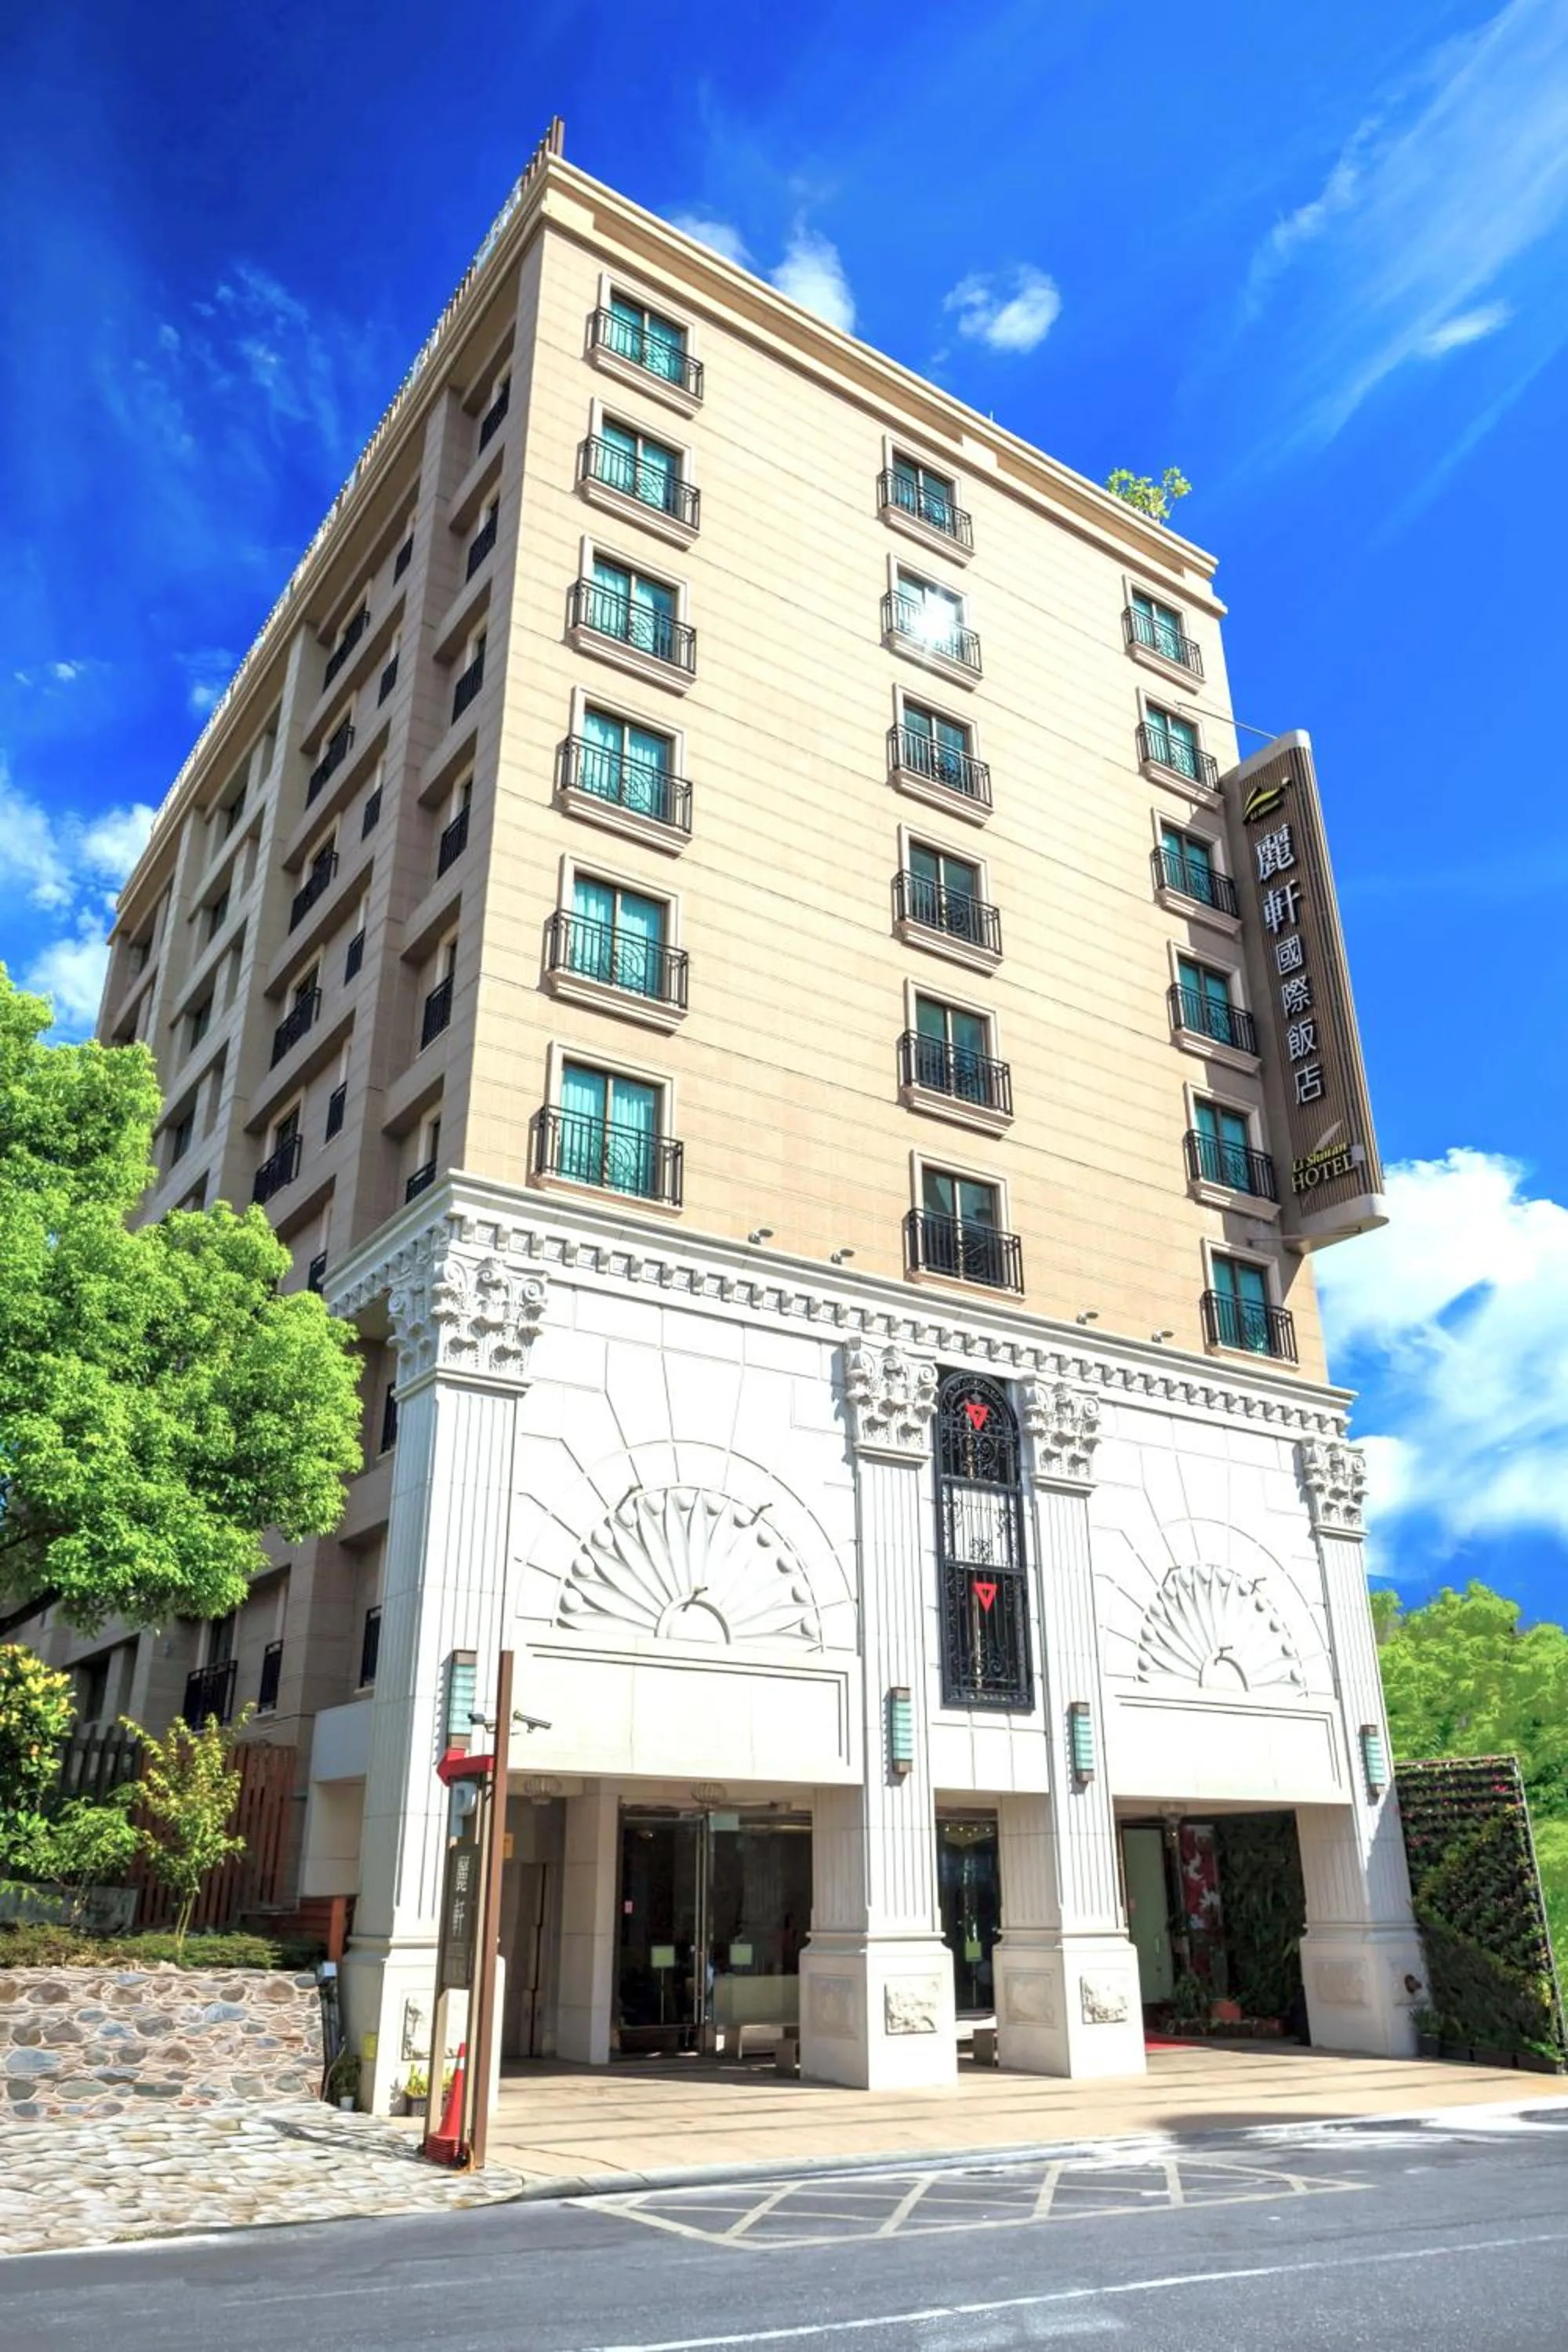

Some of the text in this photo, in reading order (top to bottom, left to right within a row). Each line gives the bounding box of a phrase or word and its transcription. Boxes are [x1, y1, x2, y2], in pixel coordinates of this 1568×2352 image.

[1255, 824, 1325, 1105] 麗軒國際飯店
[1291, 1152, 1356, 1192] HOTEL
[450, 1780, 477, 1838] P
